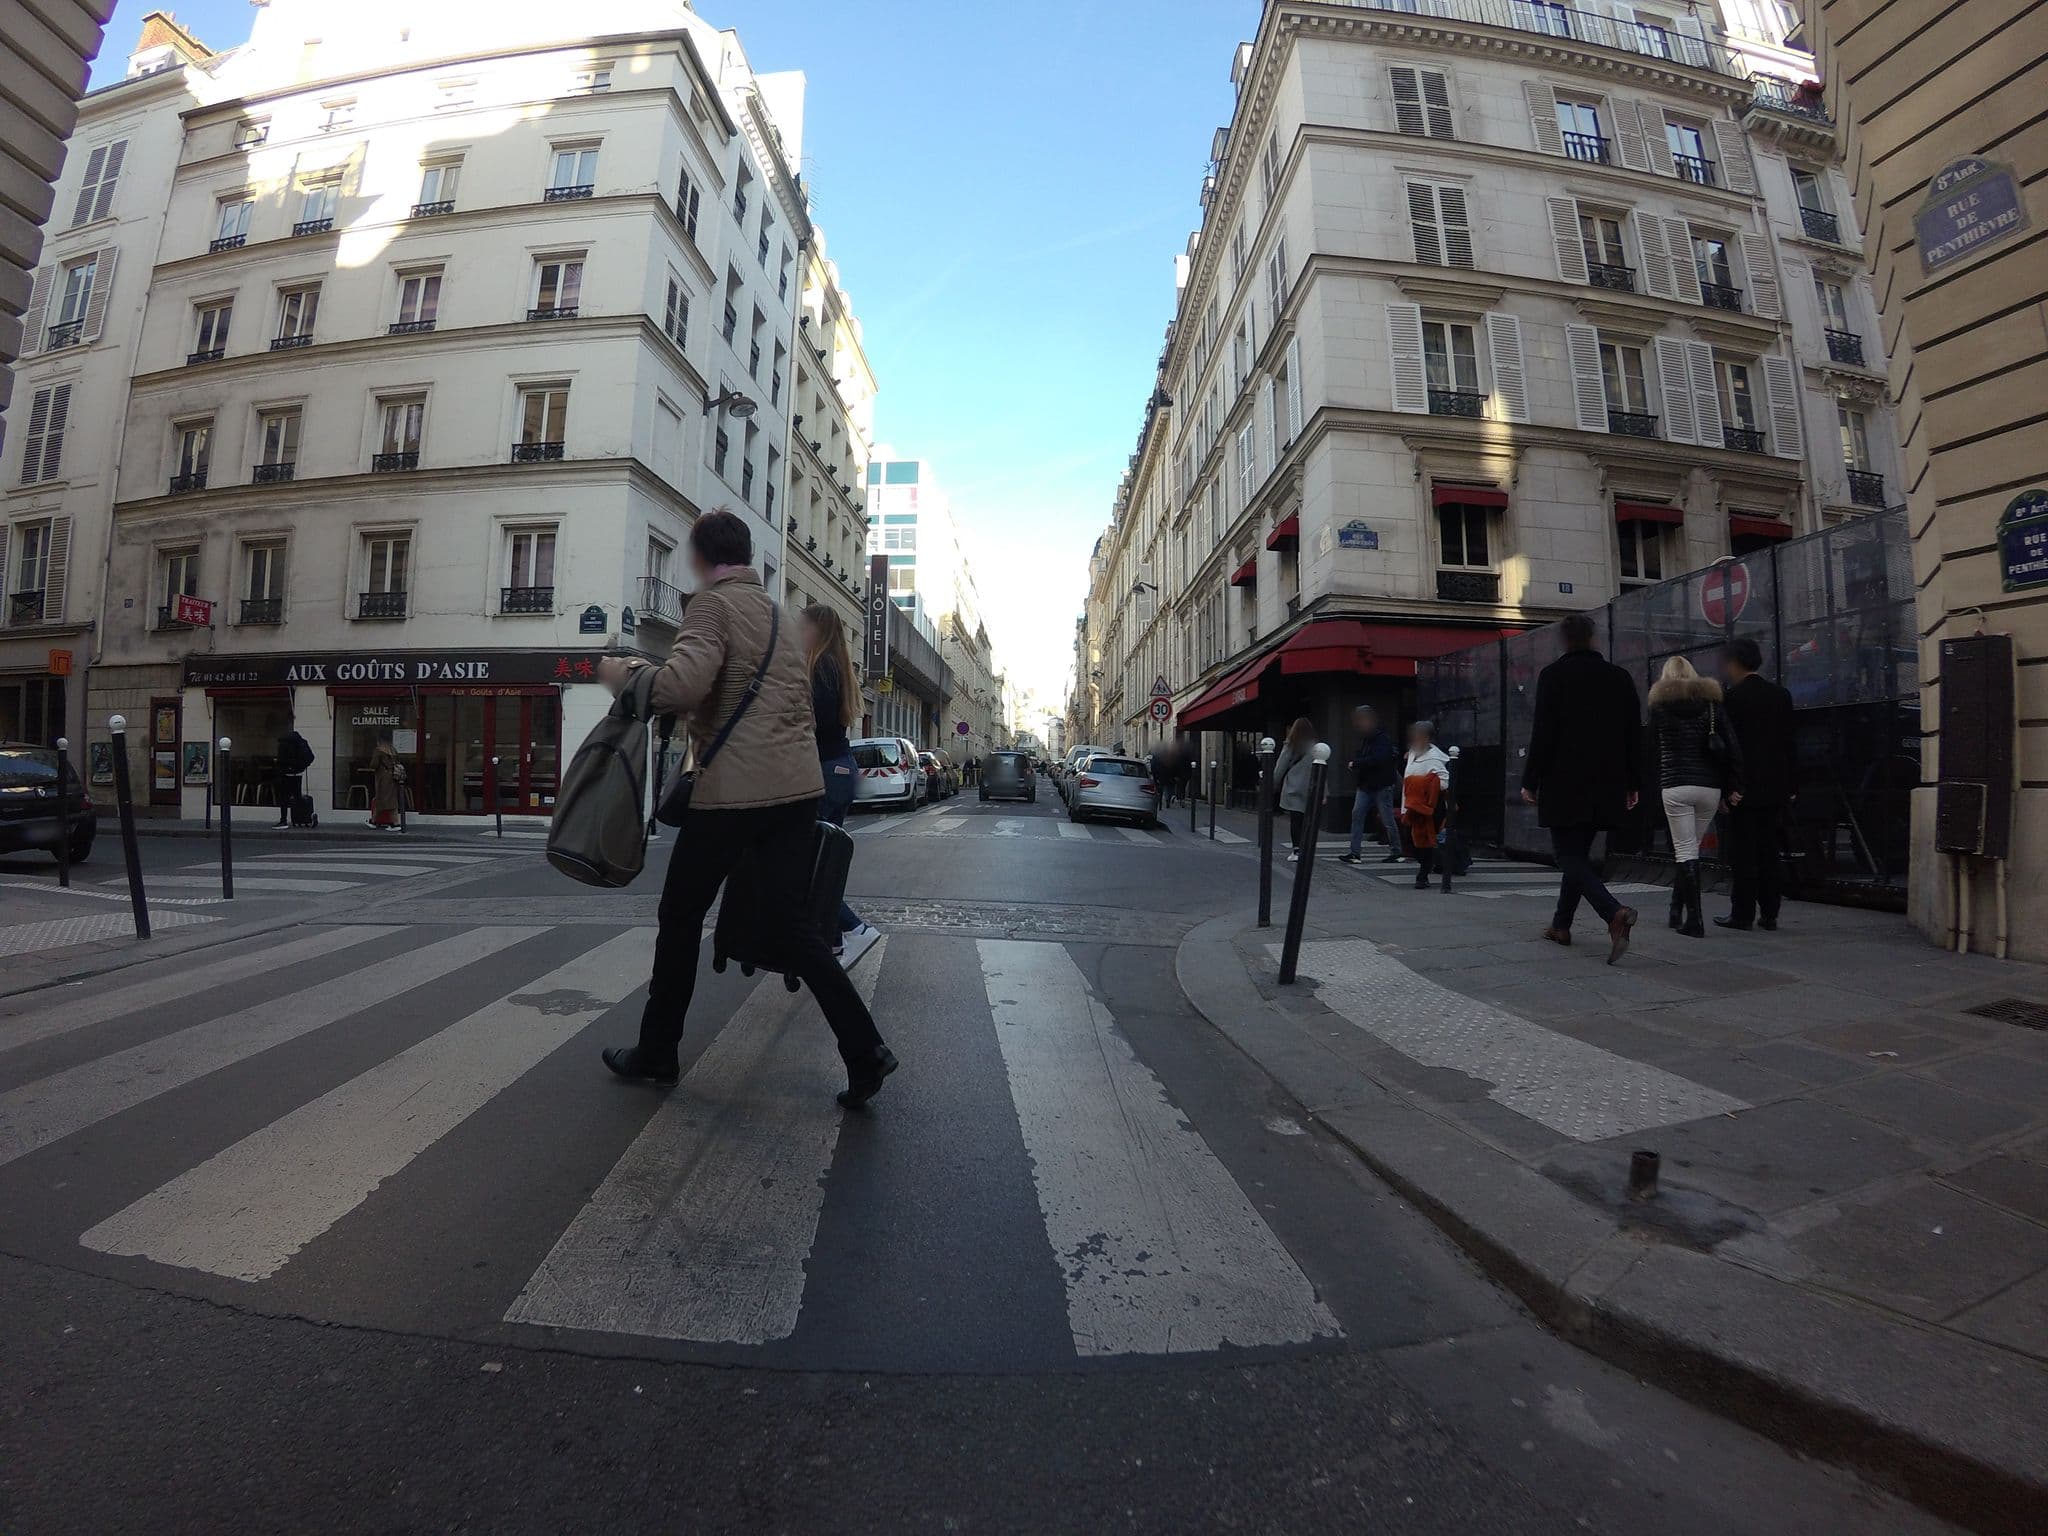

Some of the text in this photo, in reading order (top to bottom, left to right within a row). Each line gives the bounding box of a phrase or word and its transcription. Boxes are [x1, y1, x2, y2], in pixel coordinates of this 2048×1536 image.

[1947, 193, 1980, 218] RUE
[1956, 211, 1978, 230] DE
[1926, 207, 2020, 263] PENTHIÈVRE
[2024, 533, 2048, 546] RUE
[2030, 548, 2043, 557] DE
[1561, 583, 1571, 593] 18
[872, 583, 884, 656] HÔTEL
[286, 659, 490, 681] AUX GOÛTS D'ASIE
[553, 656, 593, 679] 美味
[238, 672, 246, 681] 11
[248, 672, 258, 681] 22
[451, 688, 464, 696] Aux
[363, 706, 389, 715] SALLE
[1154, 704, 1168, 715] 30
[352, 715, 400, 726] CLIMATISÉE
